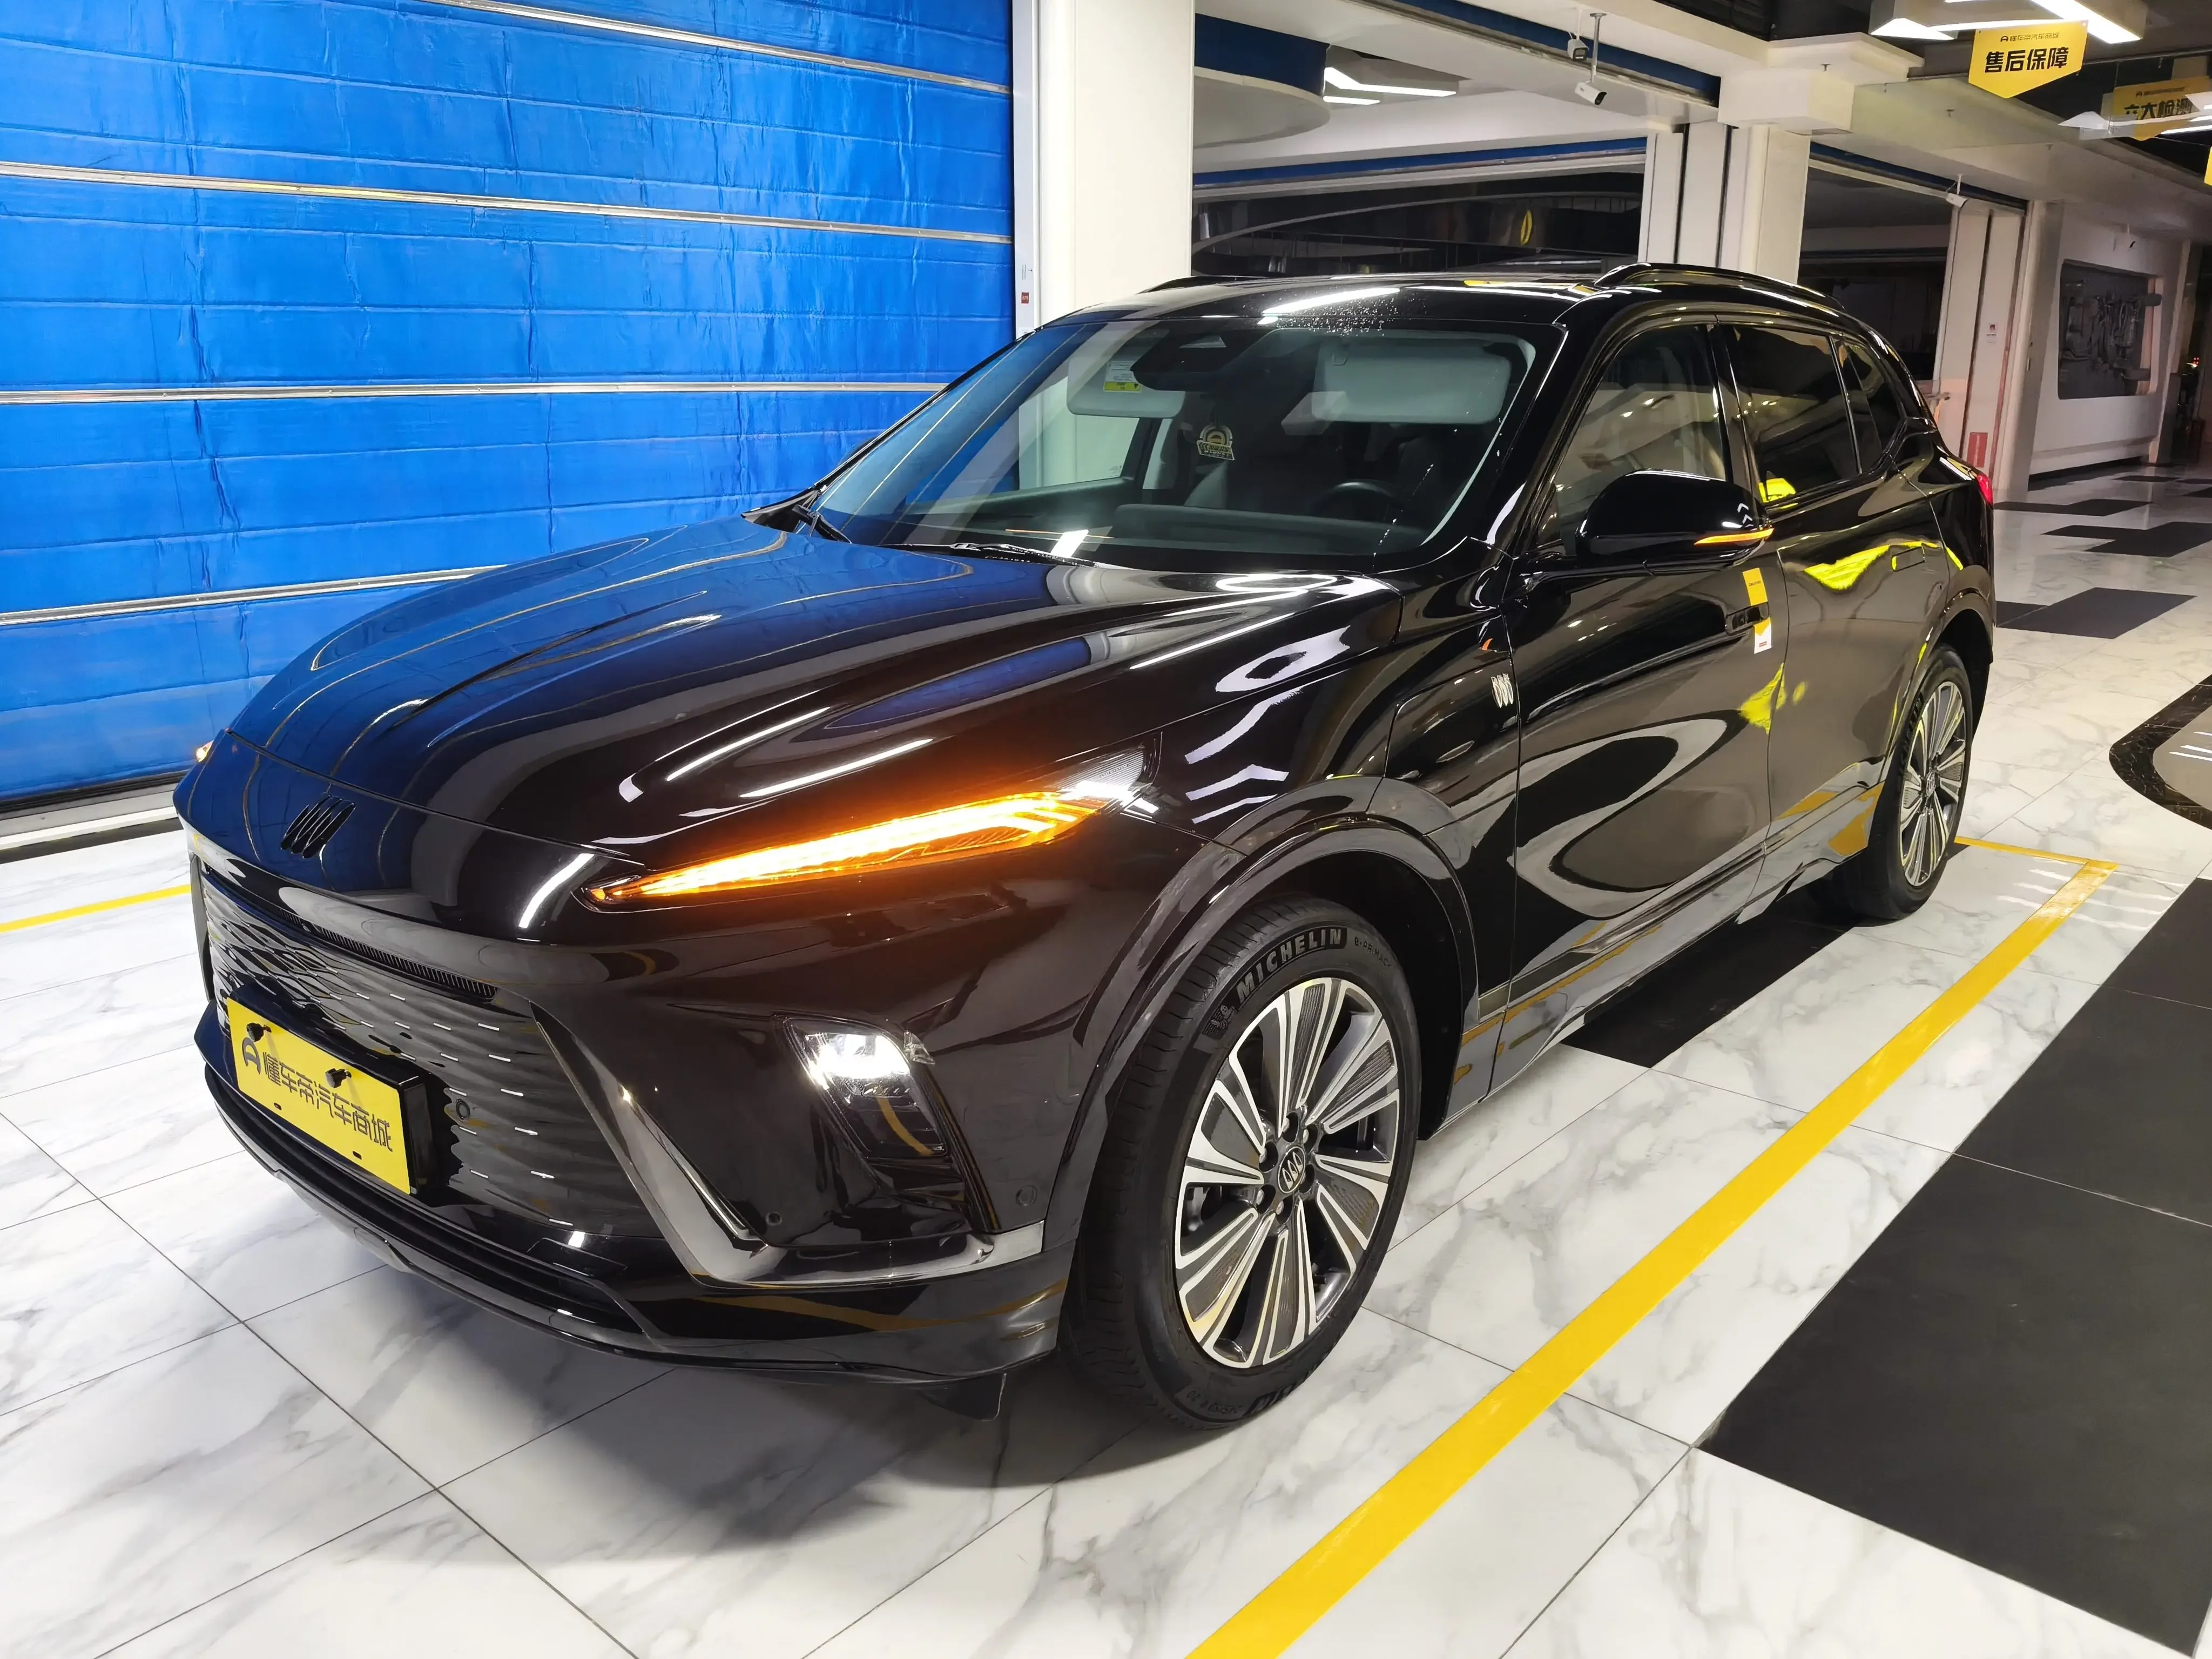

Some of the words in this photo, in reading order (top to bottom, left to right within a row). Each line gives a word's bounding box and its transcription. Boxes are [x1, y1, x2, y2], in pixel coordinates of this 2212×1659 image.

[1984, 46, 2069, 73] 售后保障
[1236, 928, 1341, 1002] MICHELIN
[262, 1051, 393, 1152] 懂车帝汽车商城
